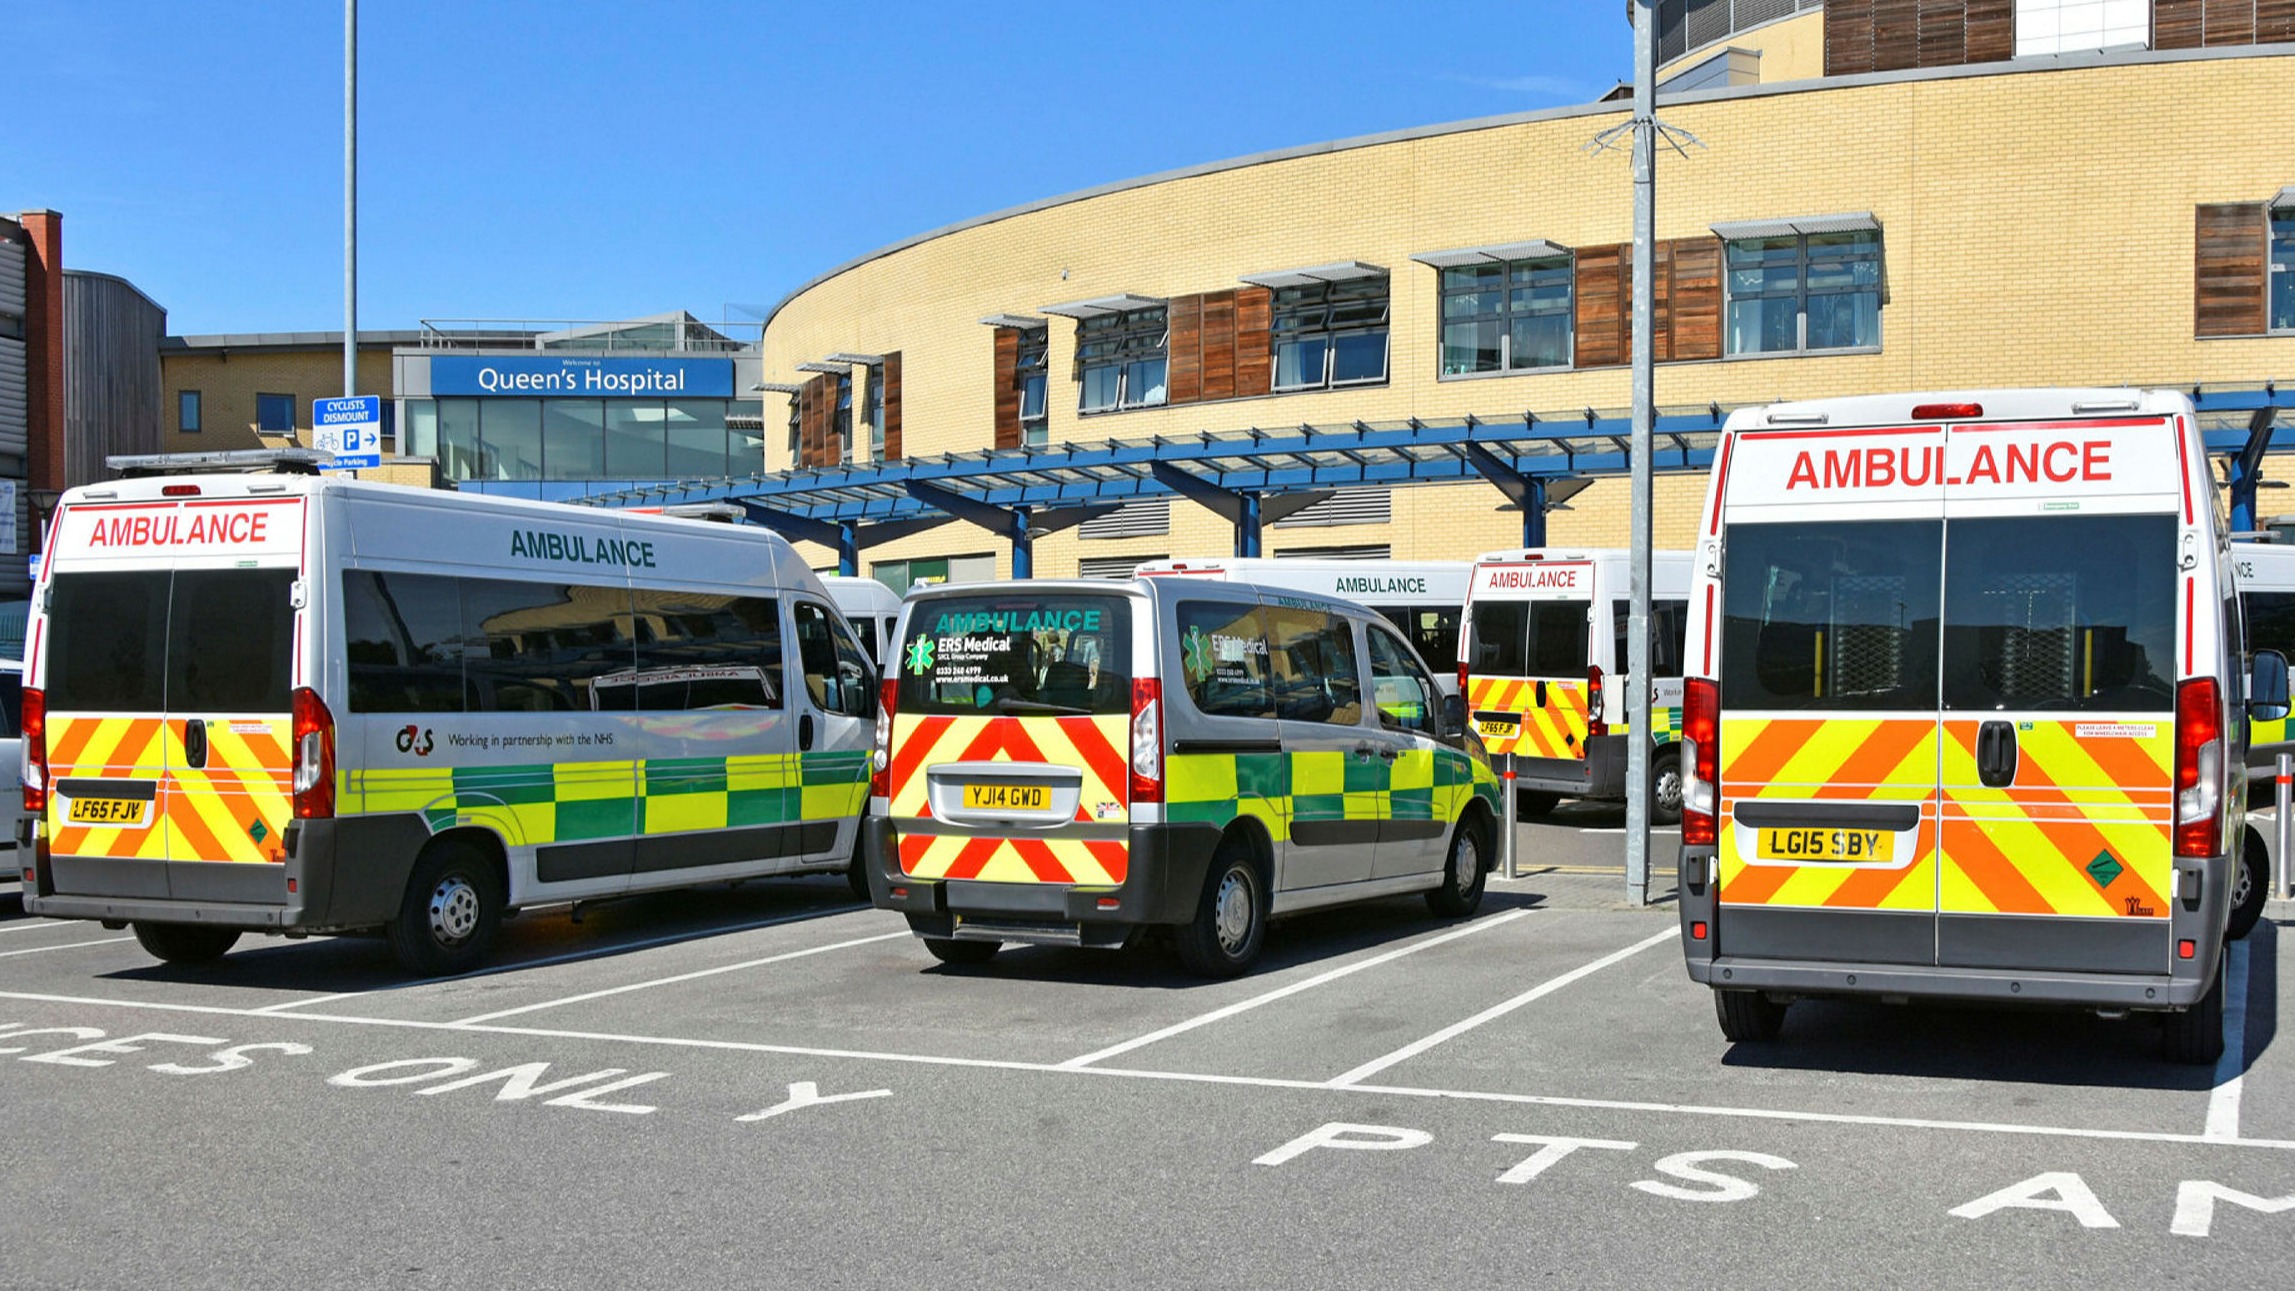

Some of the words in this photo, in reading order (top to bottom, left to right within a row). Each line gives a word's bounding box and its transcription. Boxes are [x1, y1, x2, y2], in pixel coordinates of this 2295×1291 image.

[562, 359, 592, 367] Welcome
[478, 368, 577, 392] Queen's
[585, 368, 685, 395] Hospital
[327, 400, 366, 412] CYCLISTS
[323, 411, 370, 423] DISMOUNT
[346, 432, 357, 449] P
[344, 457, 368, 467] Parking
[1785, 440, 2112, 490] AMBULANCE
[89, 513, 269, 547] AMBULANCE
[511, 530, 656, 568] AMBULANCE
[1335, 576, 1427, 594] AMBULANCE
[1488, 569, 1577, 588] AMBULANCE
[935, 610, 1101, 634] AMBULANCE
[937, 637, 962, 653] ERS
[964, 636, 1011, 652] Medical
[935, 674, 1009, 684] www.ersmedical.co.uk
[395, 725, 434, 756] G4S
[448, 734, 488, 749] Working
[491, 734, 500, 746] in
[502, 733, 552, 749] partnership
[556, 733, 574, 745] with
[577, 733, 592, 745] the
[594, 732, 614, 745] NHS
[972, 787, 1006, 807] YJ14
[1010, 787, 1041, 807] GWD
[73, 800, 109, 818] LF65
[1771, 831, 1824, 855] LG15
[1831, 831, 1878, 856] SBY
[0, 1022, 313, 1075] CES
[1252, 1121, 1799, 1202] PTS
